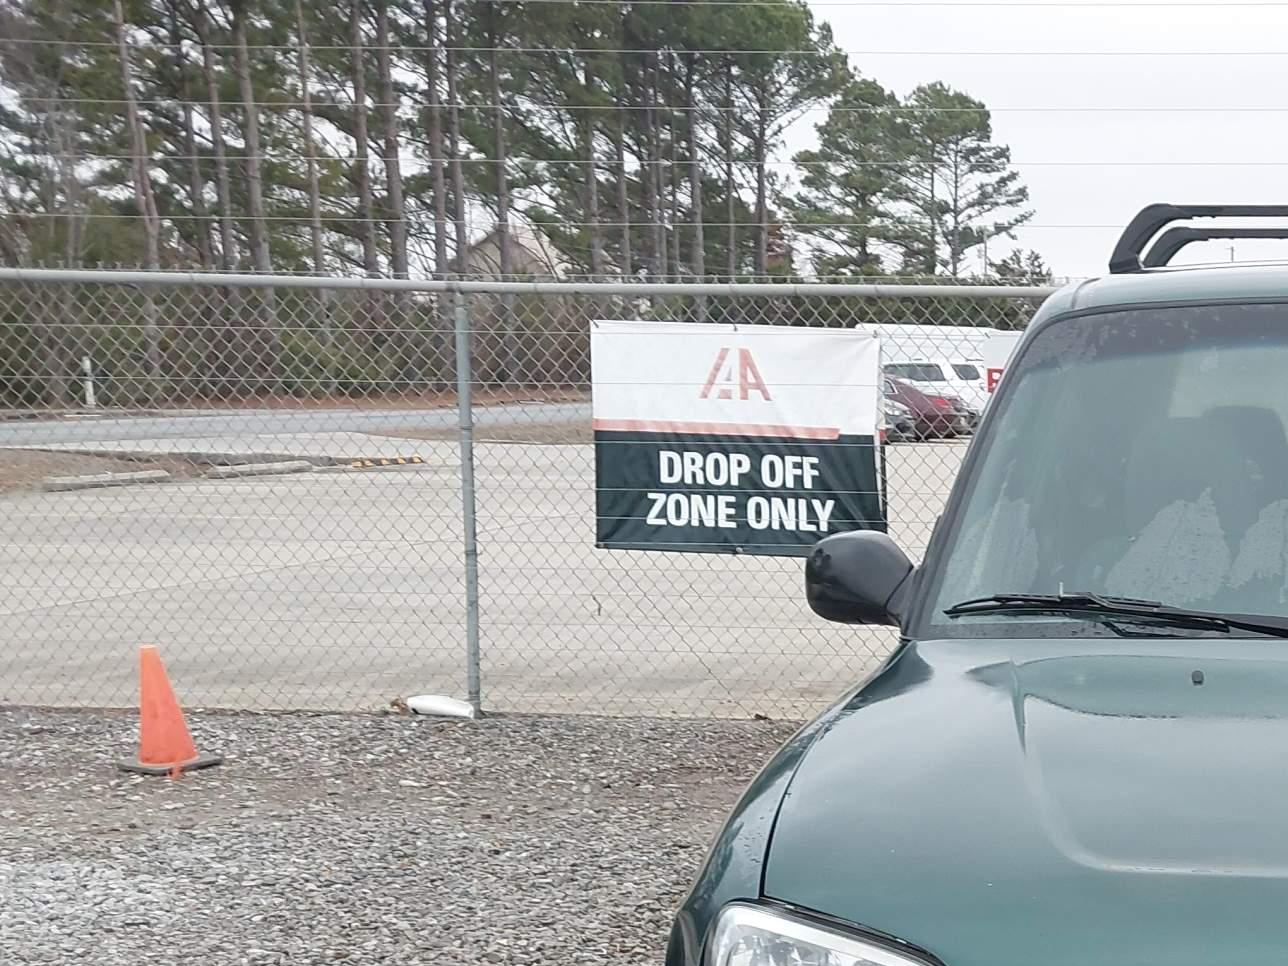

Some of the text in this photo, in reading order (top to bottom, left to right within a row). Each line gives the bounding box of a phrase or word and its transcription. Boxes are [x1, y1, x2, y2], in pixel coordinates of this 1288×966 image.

[658, 450, 819, 489] DROP OFF
[646, 493, 836, 532] ZONE ONLY
